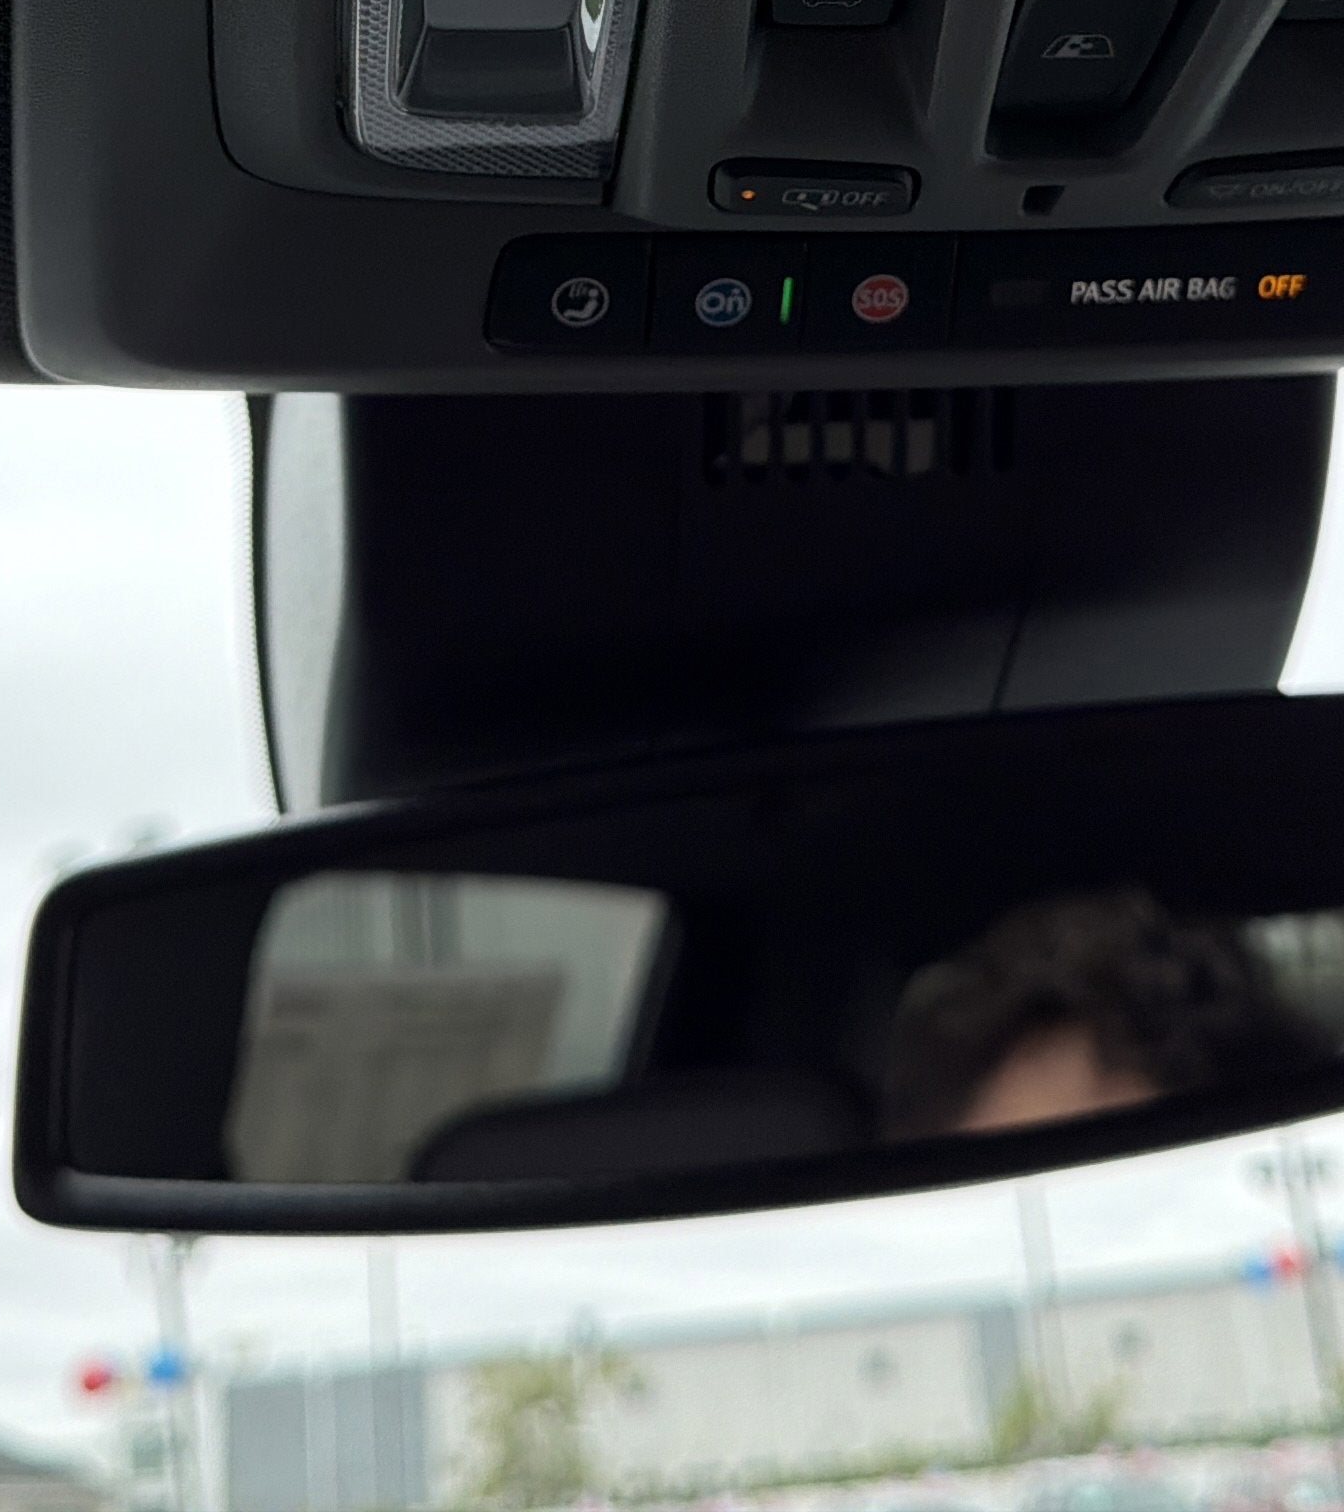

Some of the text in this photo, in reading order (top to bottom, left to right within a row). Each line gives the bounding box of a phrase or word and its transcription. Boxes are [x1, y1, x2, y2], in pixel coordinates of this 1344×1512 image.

[842, 190, 889, 207] OFF
[857, 288, 903, 310] SOS
[1070, 274, 1309, 305] PASS AIR BAG OFF
